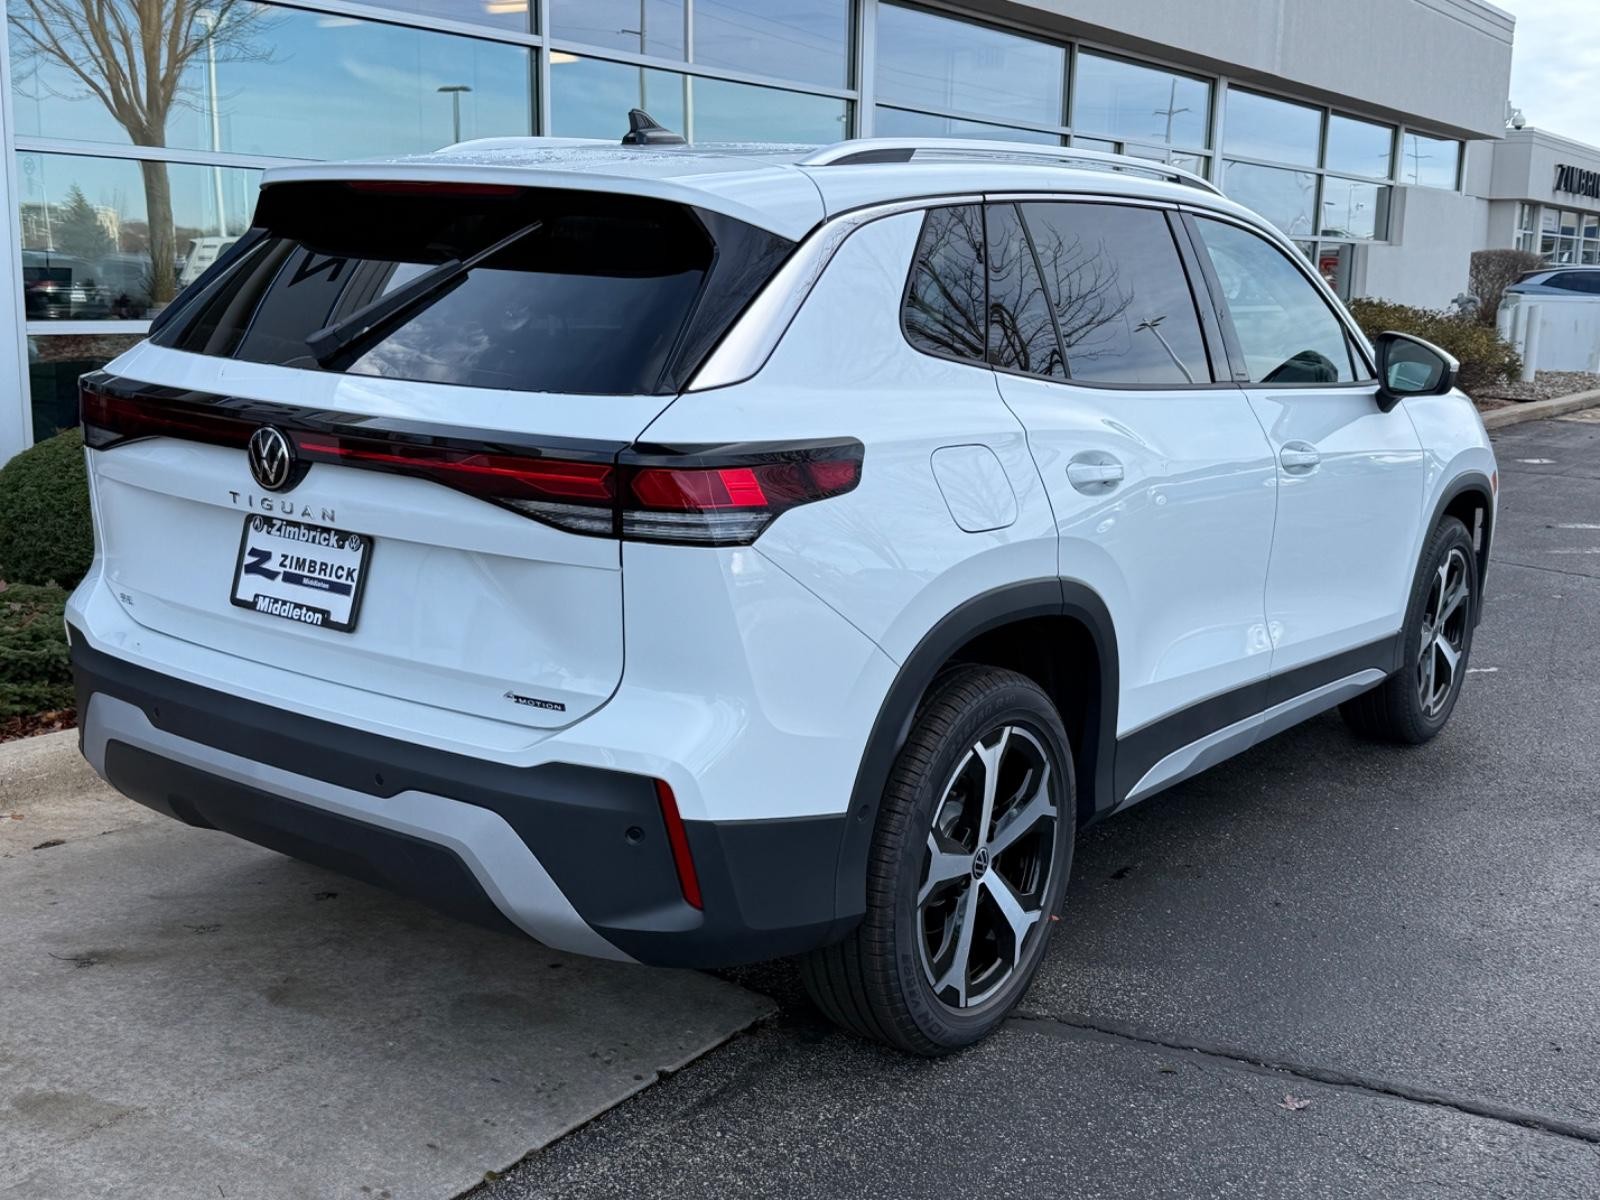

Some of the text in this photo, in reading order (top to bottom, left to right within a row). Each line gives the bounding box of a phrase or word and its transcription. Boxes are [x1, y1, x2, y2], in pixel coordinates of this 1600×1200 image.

[1553, 164, 1600, 199] ZIMBRI
[229, 491, 336, 522] TIGUAN
[270, 519, 339, 548] Zimbrick
[279, 553, 357, 583] ZIMBRICK
[256, 596, 322, 625] Middleton
